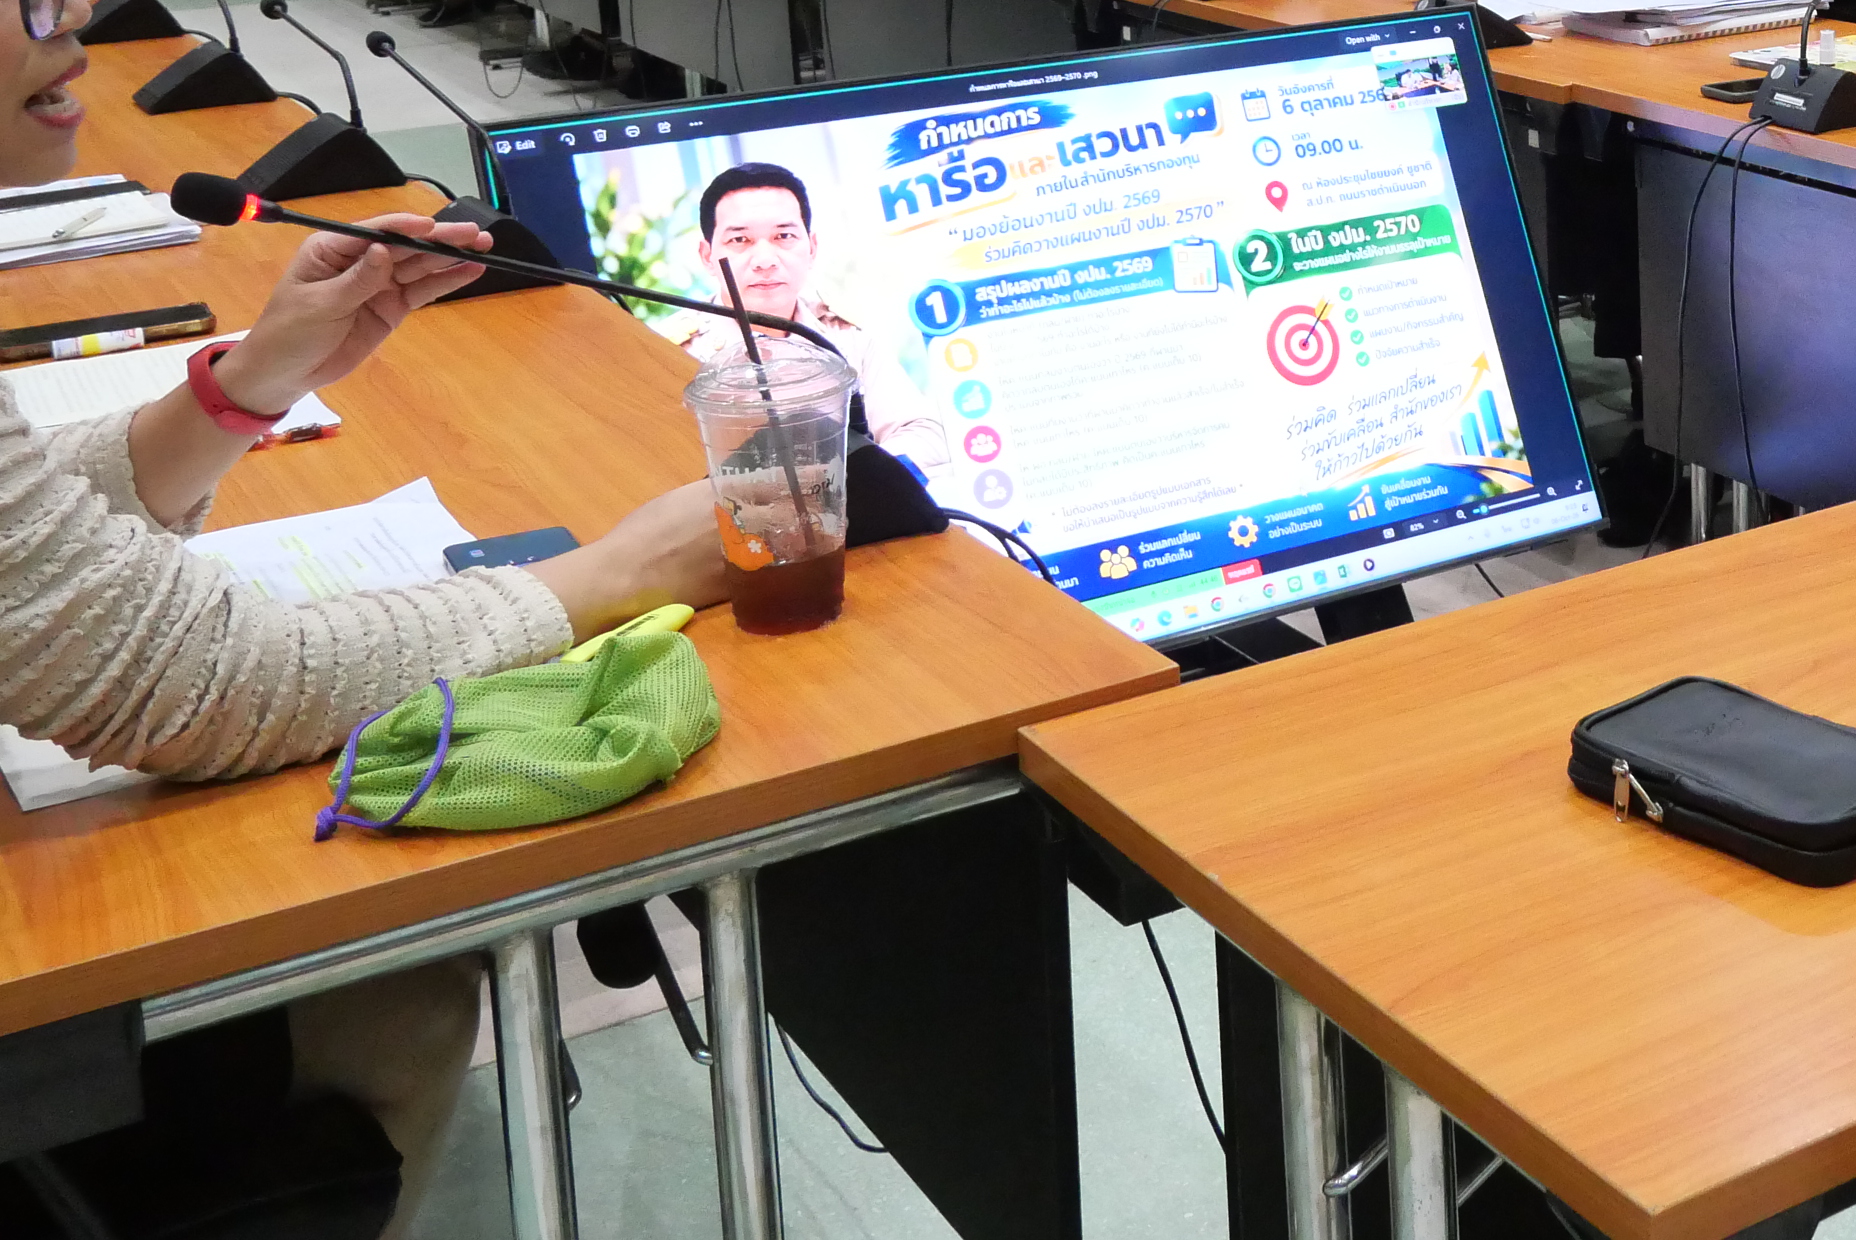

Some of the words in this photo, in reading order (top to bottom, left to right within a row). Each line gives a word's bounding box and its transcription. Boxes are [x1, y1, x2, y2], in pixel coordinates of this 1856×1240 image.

[1343, 34, 1365, 45] Open
[1363, 31, 1381, 42] with
[1082, 69, 1100, 80] .png
[1275, 76, 1334, 97] วันอังคารที่
[1279, 99, 1295, 116] 6
[1298, 90, 1356, 118] ตุลาคม
[1356, 87, 1387, 105] 256
[916, 105, 1043, 151] กำหนดการ
[1290, 130, 1311, 142] เวลา
[513, 139, 536, 151] Edit
[1293, 136, 1345, 160] 09.00
[1346, 136, 1364, 151] น.
[1033, 151, 1201, 197] ภายในสำนักบริหารกองทุน
[1300, 180, 1313, 191] ณ
[1082, 198, 1117, 217] งปม.
[1120, 188, 1162, 210] 2569
[982, 217, 1132, 264] ร่วมคิดวางแผนงานปี
[1135, 213, 1169, 233] งปม.
[1287, 230, 1325, 255] ในปี
[1326, 222, 1372, 248] งปม.
[1372, 213, 1422, 240] 2570
[1243, 238, 1273, 273] 2
[973, 270, 1070, 305] สรุปผลงานปี
[1072, 263, 1111, 285] งปม.
[1111, 255, 1153, 277] 2569
[923, 291, 948, 326] 1
[1284, 406, 1338, 440] ร่วมคิด
[1347, 371, 1437, 417] ร่วมแลกเปลี่ยน
[1299, 414, 1385, 462] ร่วมขับเคลื่อน
[1387, 383, 1463, 425] สำนักของเรา
[1313, 421, 1424, 481] ให้ก้าวไปด้วยกัน
[1136, 526, 1201, 555] ร่วมแลกเปลี่ยน
[1140, 544, 1193, 570] ความคิดเห็น
